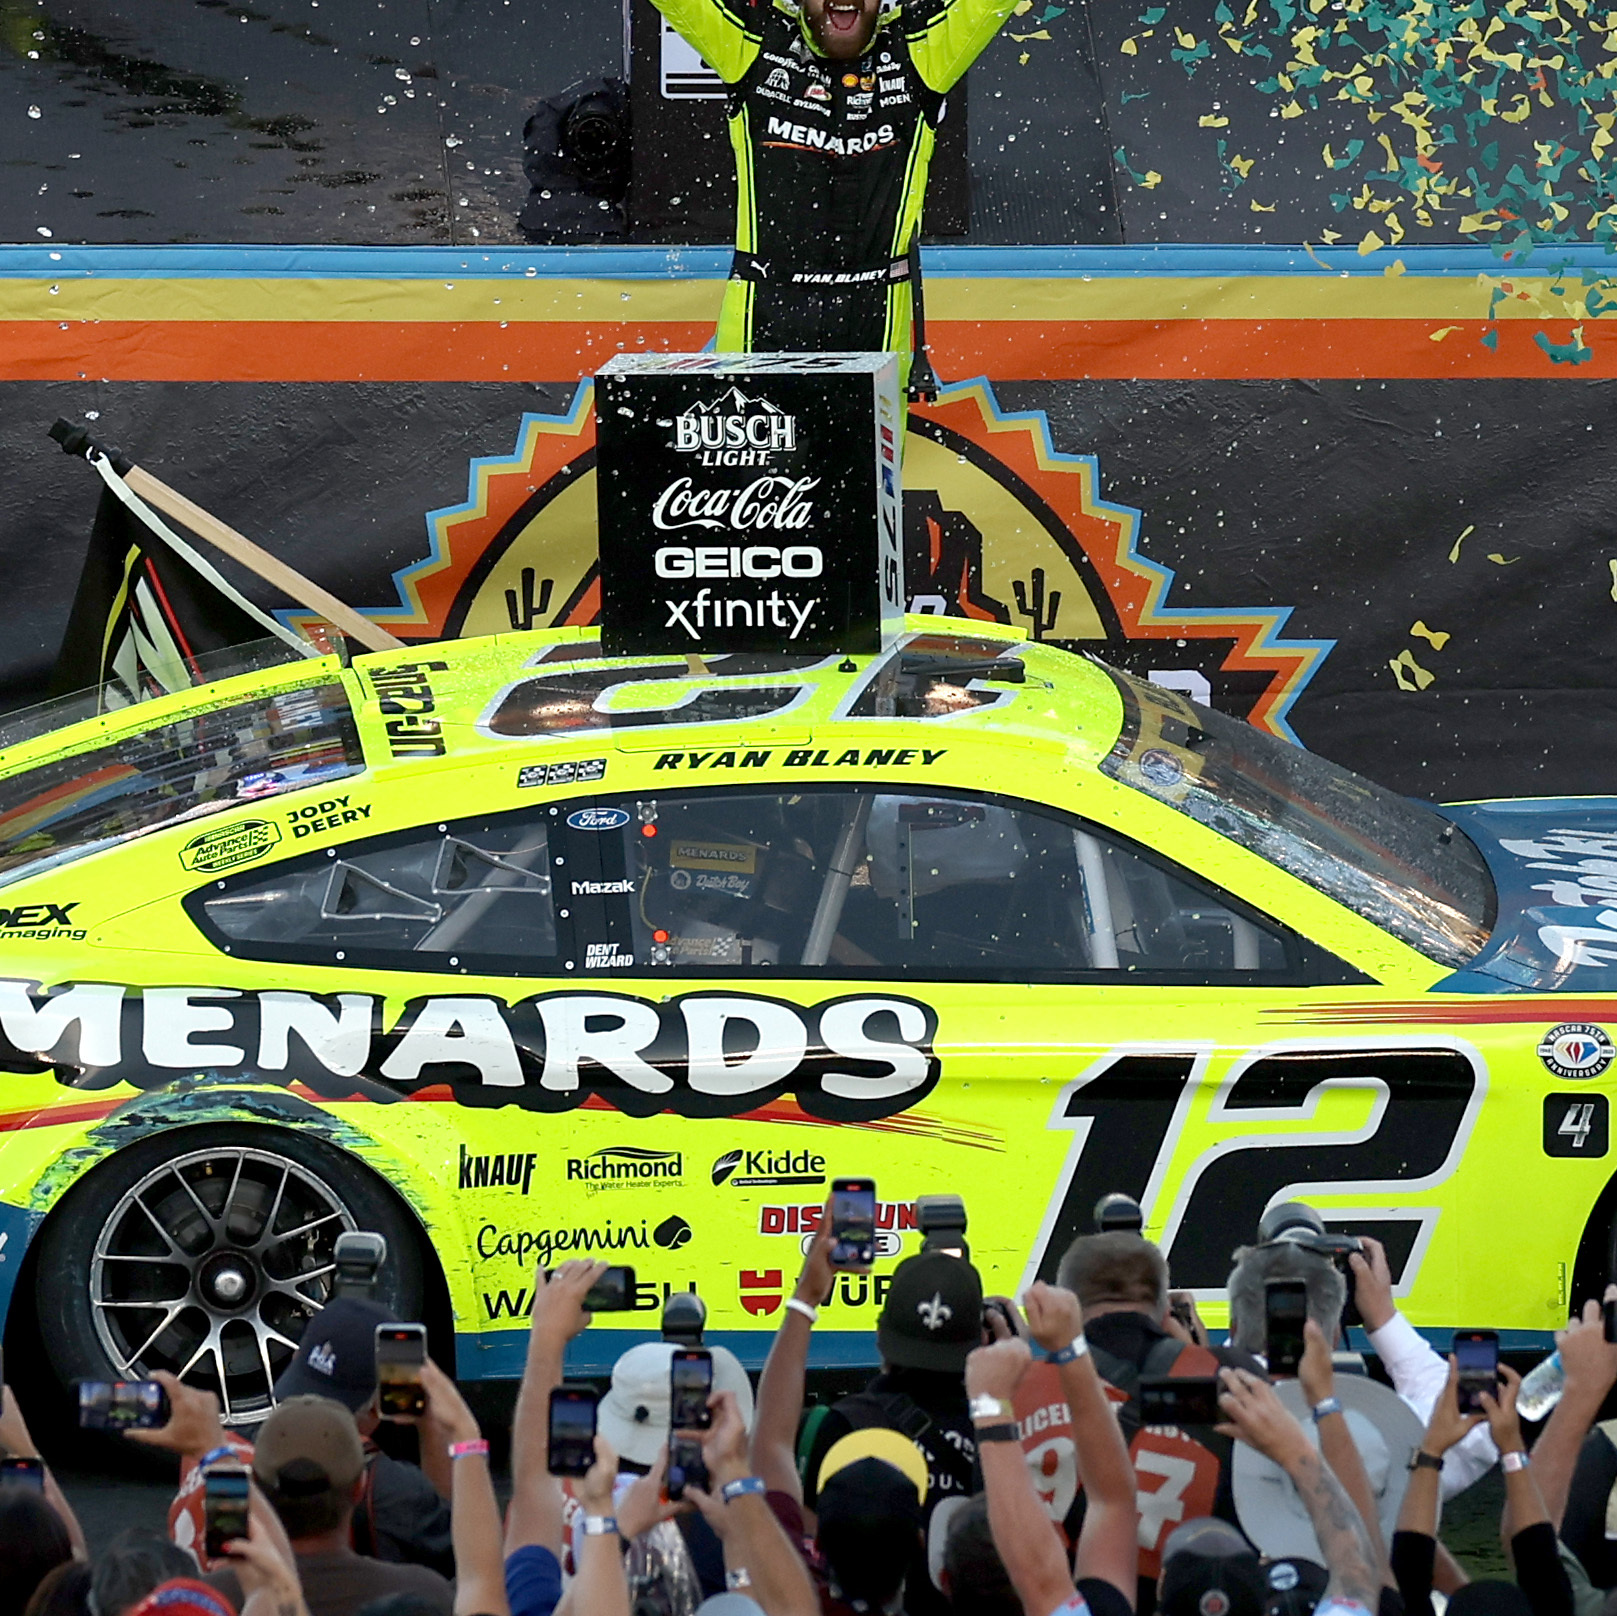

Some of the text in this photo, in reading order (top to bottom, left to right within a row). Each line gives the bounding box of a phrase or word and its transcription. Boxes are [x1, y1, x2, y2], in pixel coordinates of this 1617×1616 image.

[879, 93, 912, 108] MOEN
[767, 116, 895, 156] MENARDS
[791, 268, 888, 285] RYAN BLANEY
[674, 414, 798, 452] BUSCH
[700, 450, 771, 467] LIGHT
[652, 476, 822, 531] Coca-Cola
[654, 546, 823, 579] GEICO
[664, 587, 816, 641] xfinity
[653, 748, 947, 770] RYAN BLANEY
[286, 795, 351, 824] JODY
[292, 804, 373, 839] DEERY
[574, 809, 623, 829] Ford
[192, 840, 250, 868] Auto Parts
[196, 833, 250, 857] Advance
[676, 846, 747, 862] MENARDS
[571, 879, 635, 895] Mazak
[584, 953, 634, 969] WIZARD
[586, 942, 620, 957] DENT
[1546, 1023, 1607, 1044] NASCAR 75TH
[1545, 1056, 1609, 1078] ANNIVERSARY
[1557, 1103, 1595, 1148] 4
[458, 1144, 826, 1194] KNAUF Richmond Kidde
[1020, 1036, 1486, 1301] 12
[476, 1218, 651, 1269] Capgemini
